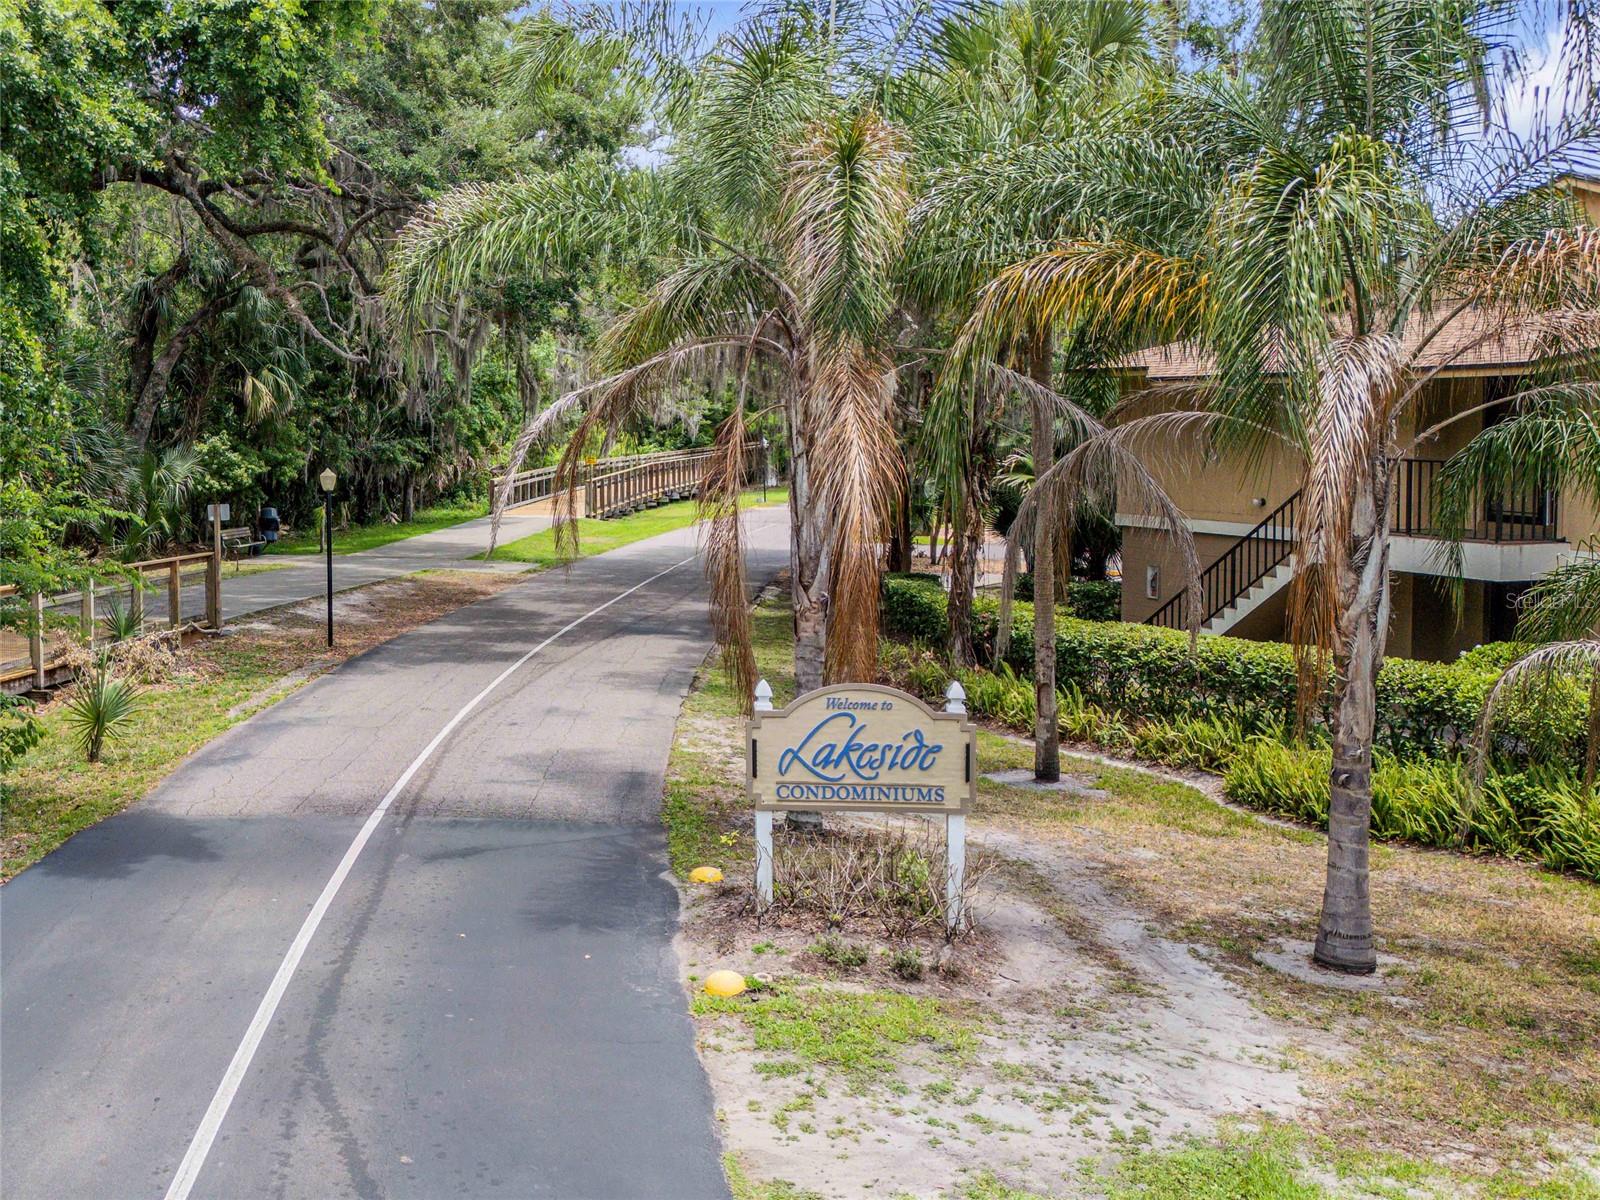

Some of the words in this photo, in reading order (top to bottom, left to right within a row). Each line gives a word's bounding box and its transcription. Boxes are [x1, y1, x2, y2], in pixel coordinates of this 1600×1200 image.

[826, 697, 877, 711] Welcome
[880, 701, 893, 711] to
[778, 711, 943, 782] Lakeside
[776, 784, 945, 802] CONDOMINIUMS
